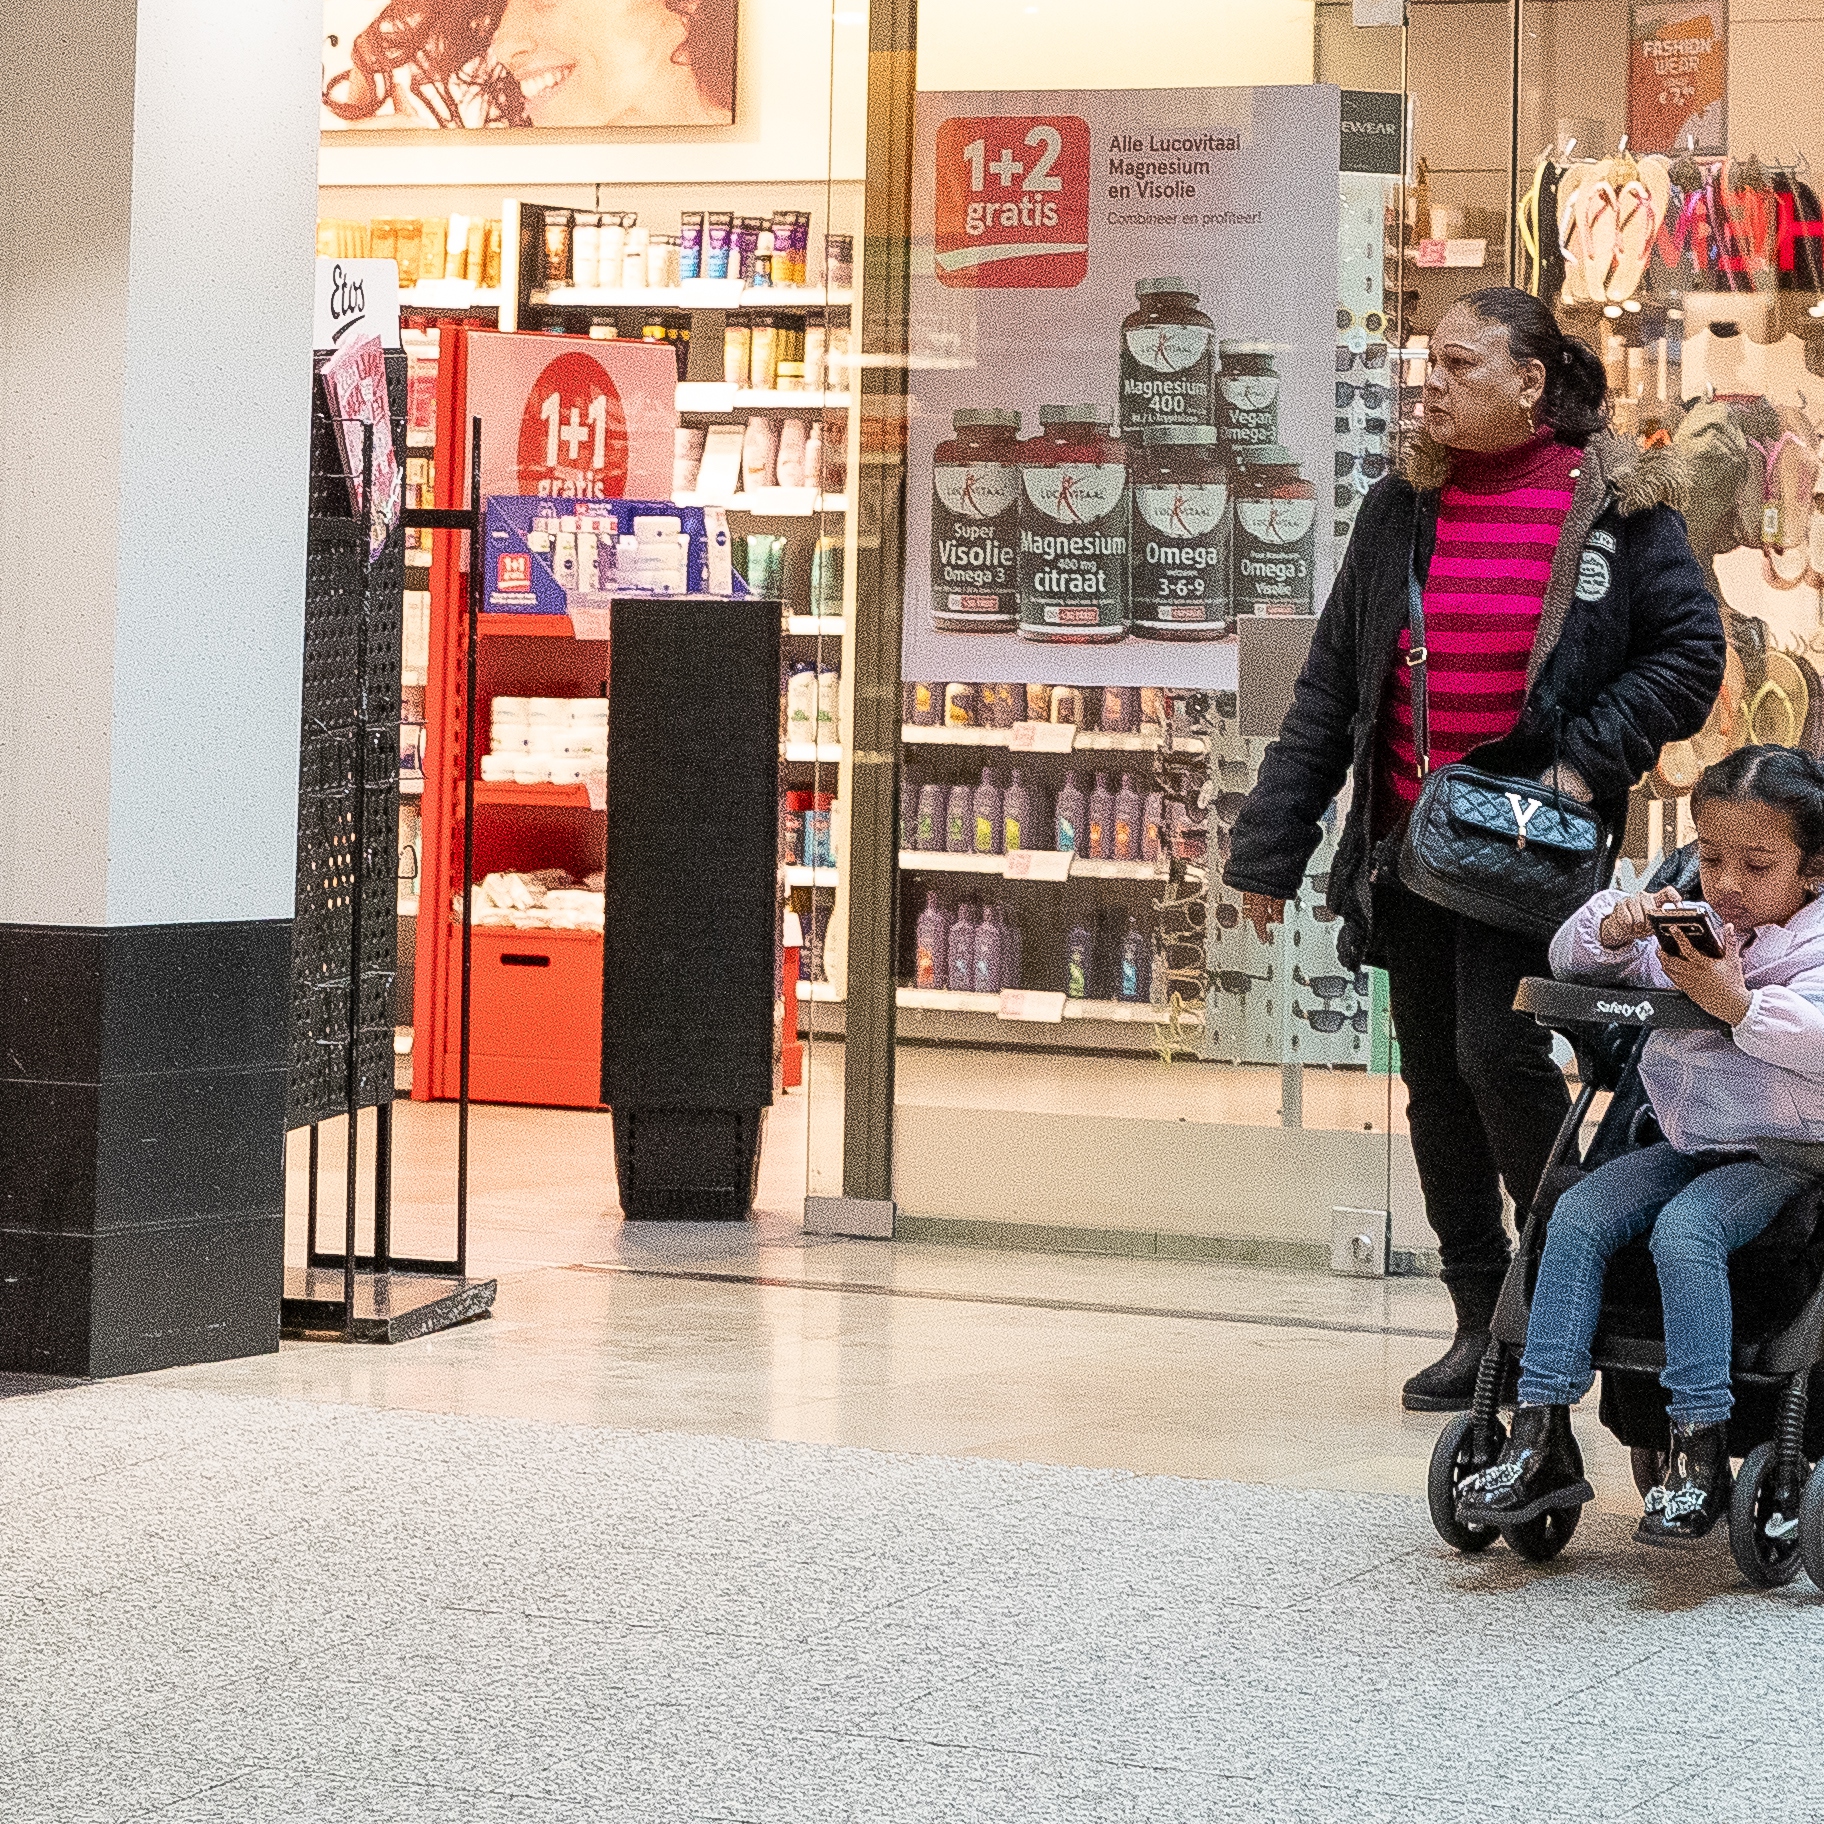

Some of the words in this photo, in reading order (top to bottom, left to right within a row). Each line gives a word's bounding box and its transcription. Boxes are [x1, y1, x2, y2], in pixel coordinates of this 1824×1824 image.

[1108, 135, 1144, 152] Alle
[1149, 133, 1242, 153] Lucovitaal
[961, 124, 1064, 194] 1+2
[1108, 157, 1211, 179] Magnesium
[1108, 184, 1133, 199] en
[1136, 181, 1197, 199] Visolie
[964, 192, 1059, 237] gratis
[330, 262, 366, 318] Etos
[1123, 377, 1208, 398] Magnesium
[1149, 395, 1186, 413] 400
[537, 391, 607, 470] 1+1
[954, 522, 995, 542] Super
[938, 539, 1016, 567] Visolie
[1021, 531, 1127, 560] Magnesium
[1145, 541, 1219, 569] Omega
[944, 566, 993, 585] Omega
[995, 567, 1006, 583] 3
[1033, 566, 1107, 594] citraat
[1240, 559, 1295, 581] Omega
[1297, 559, 1307, 576] 3
[1157, 578, 1206, 596] 3-6-9
[1595, 999, 1636, 1018] Safety
